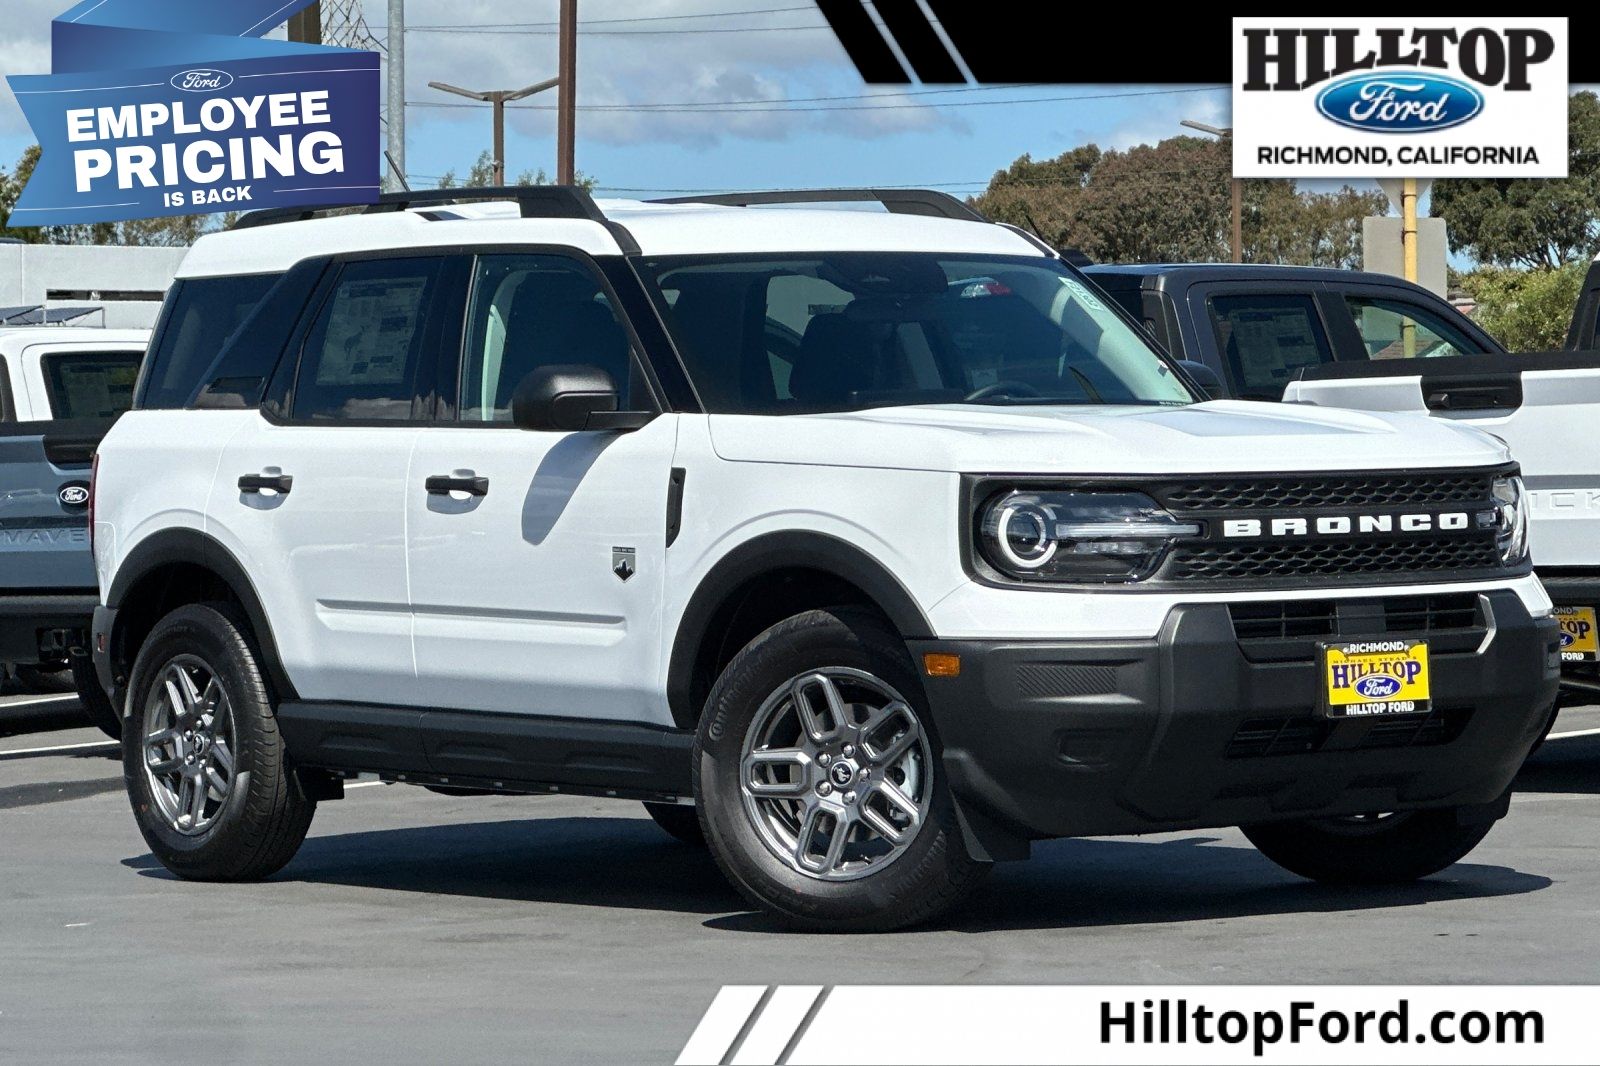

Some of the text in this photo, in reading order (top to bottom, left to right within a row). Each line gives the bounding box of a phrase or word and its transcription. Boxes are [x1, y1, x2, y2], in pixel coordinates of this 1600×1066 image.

[1223, 512, 1469, 537] BRONCO
[1350, 641, 1404, 653] RICHMOND
[1561, 652, 1584, 661] FORD
[1332, 660, 1421, 689] HILLTOP
[1363, 678, 1394, 696] Ford
[1346, 701, 1415, 715] HILLTOP FORD
